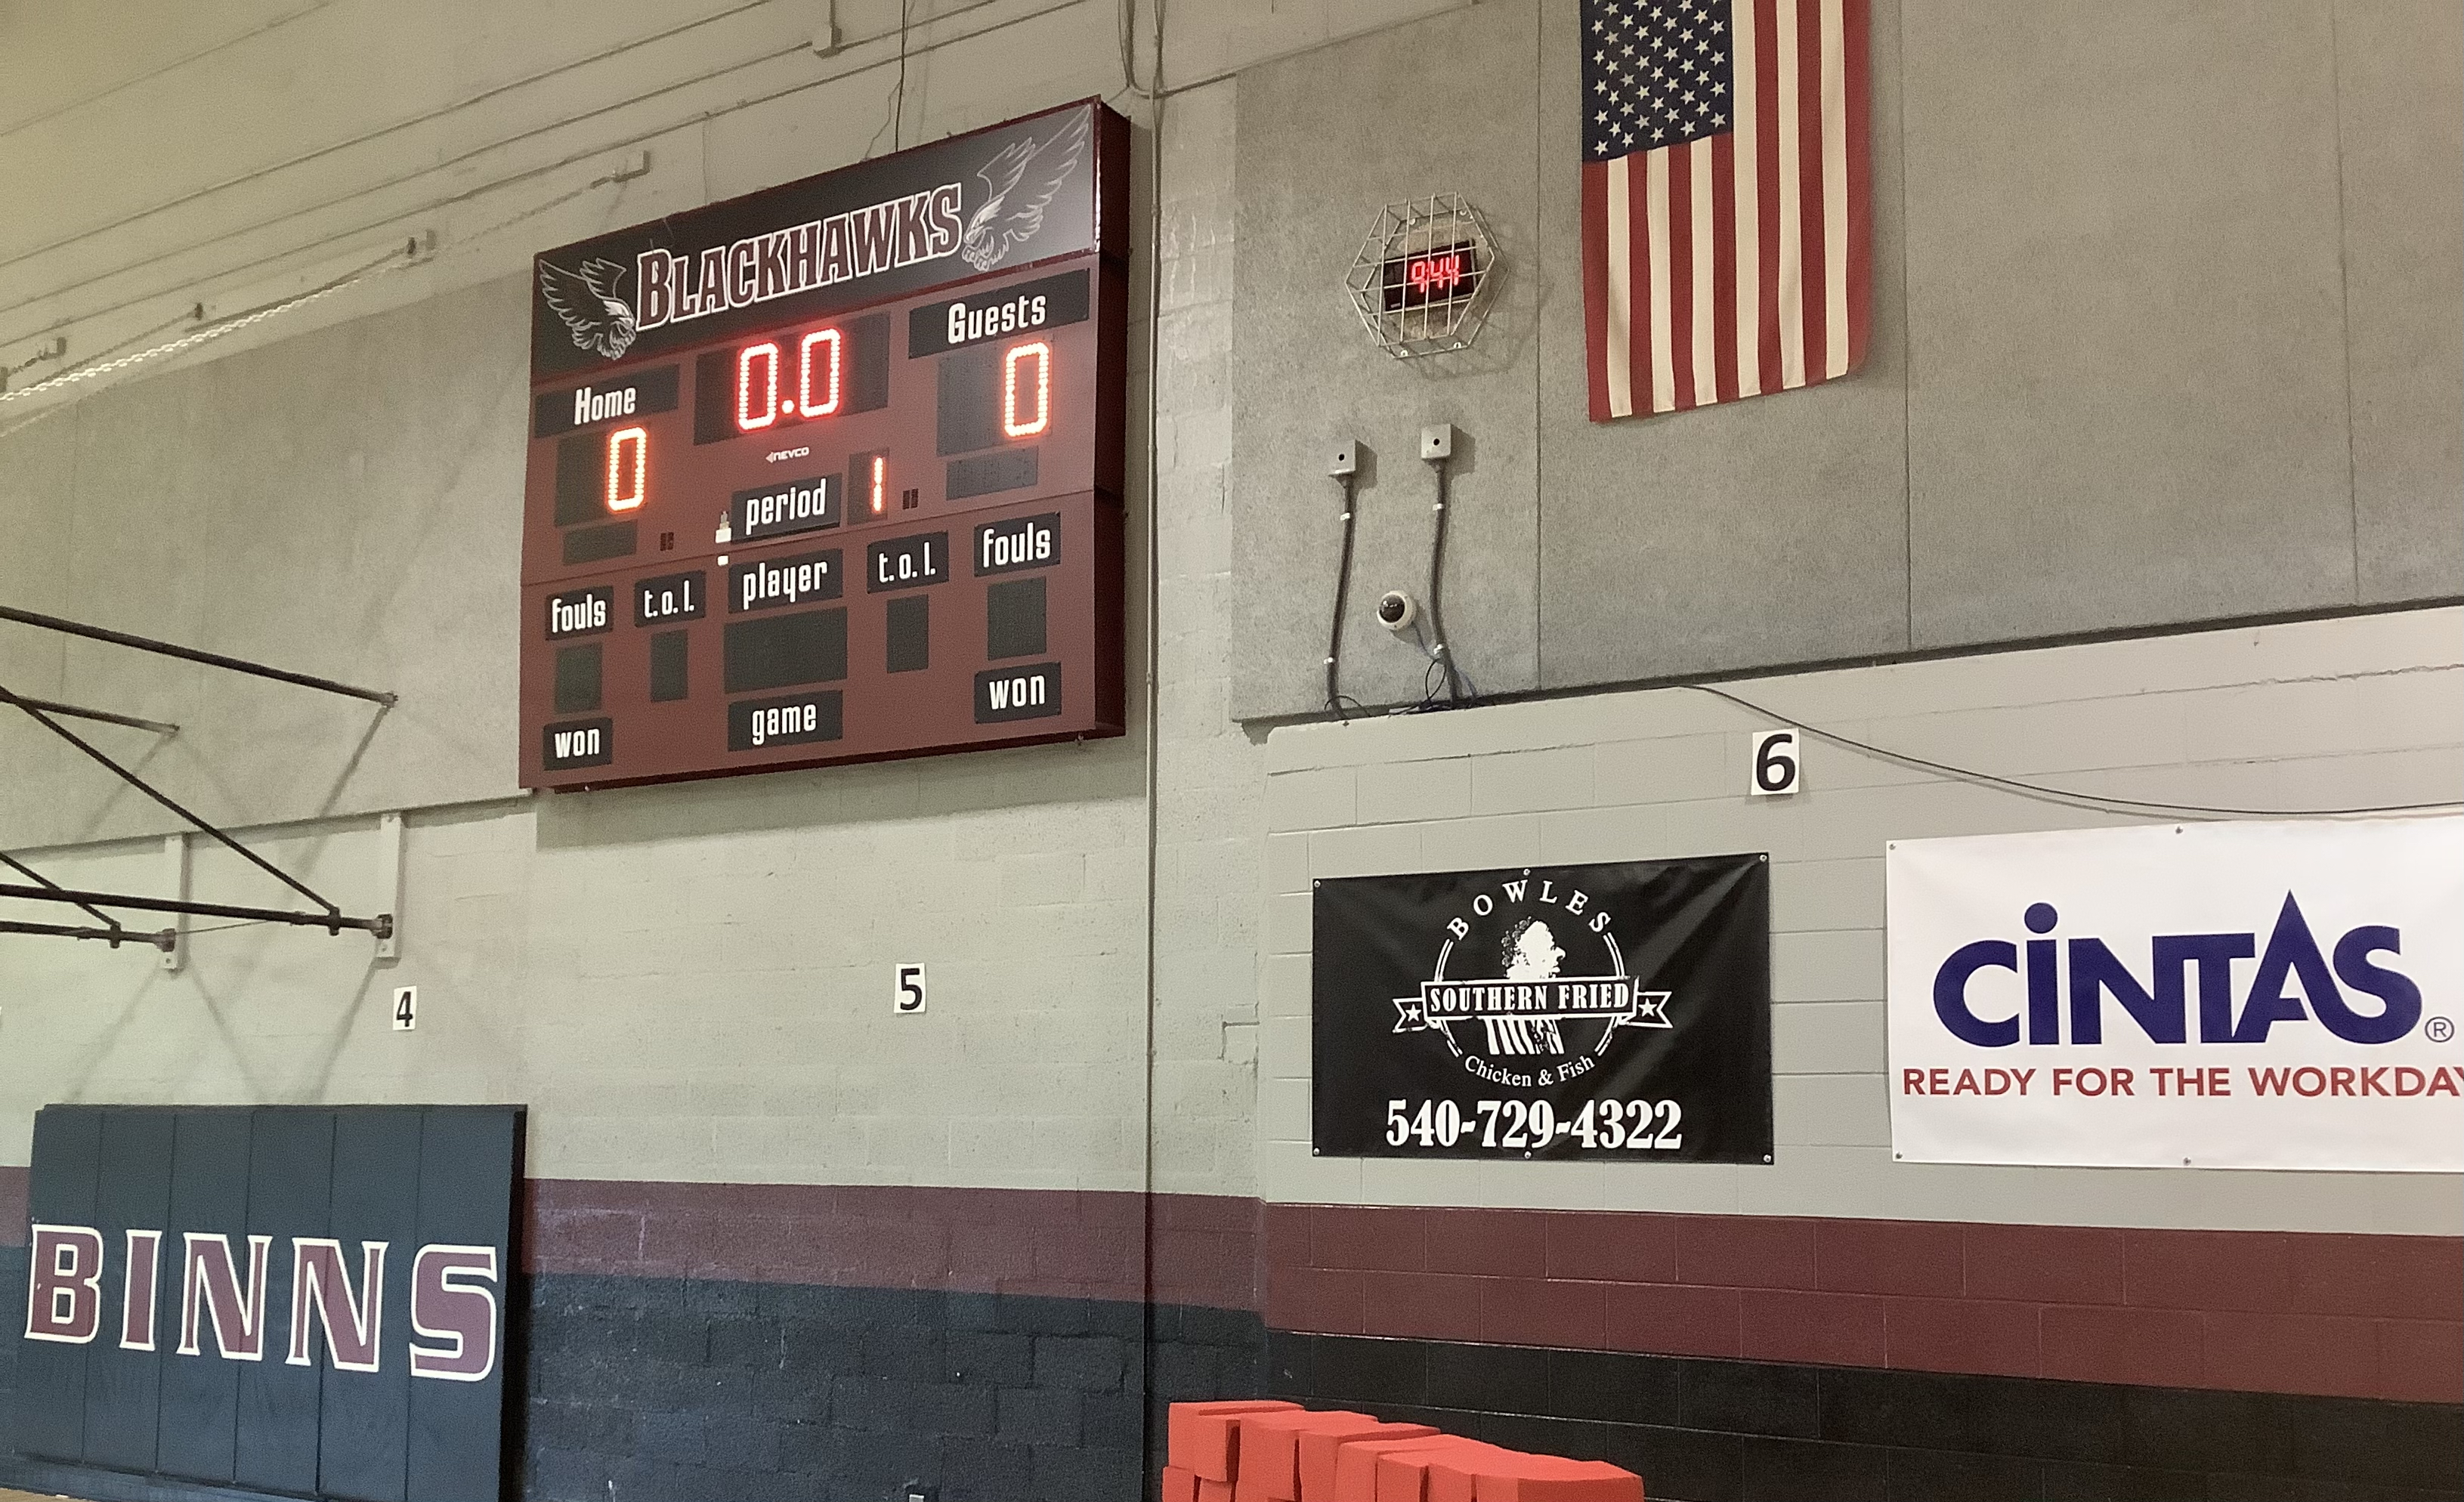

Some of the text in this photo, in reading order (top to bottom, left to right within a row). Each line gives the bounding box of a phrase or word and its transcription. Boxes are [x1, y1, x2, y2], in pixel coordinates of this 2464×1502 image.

[635, 182, 962, 332] BLACKHAWKS
[948, 295, 1047, 344] Guests
[738, 328, 841, 430] 0.0
[1003, 342, 1050, 437] 0
[574, 387, 636, 425] Home
[607, 427, 647, 511] 0
[773, 447, 810, 462] NEVCO
[873, 457, 883, 511] 1
[746, 477, 827, 536] period
[879, 542, 936, 583] t.o.l.
[983, 522, 1050, 567] fouls
[645, 579, 694, 618] t.o.l.
[743, 561, 827, 609] player
[552, 594, 606, 633] fouls
[989, 675, 1045, 709] won
[555, 728, 600, 759] won
[752, 704, 816, 746] game
[1756, 734, 1795, 792] 6
[1446, 879, 1611, 940] BOWLES
[396, 991, 413, 1028] 4
[900, 967, 923, 1011] 5
[1430, 982, 1629, 1012] SOUTHERN FRIED
[1465, 1054, 1595, 1087] Chicken & Fish
[1903, 1068, 2036, 1097] READY
[2051, 1067, 2135, 1097] FOR
[2149, 1067, 2231, 1097] THE
[1386, 1099, 1682, 1149] 540-729-4322
[24, 1224, 499, 1382] BINNS
